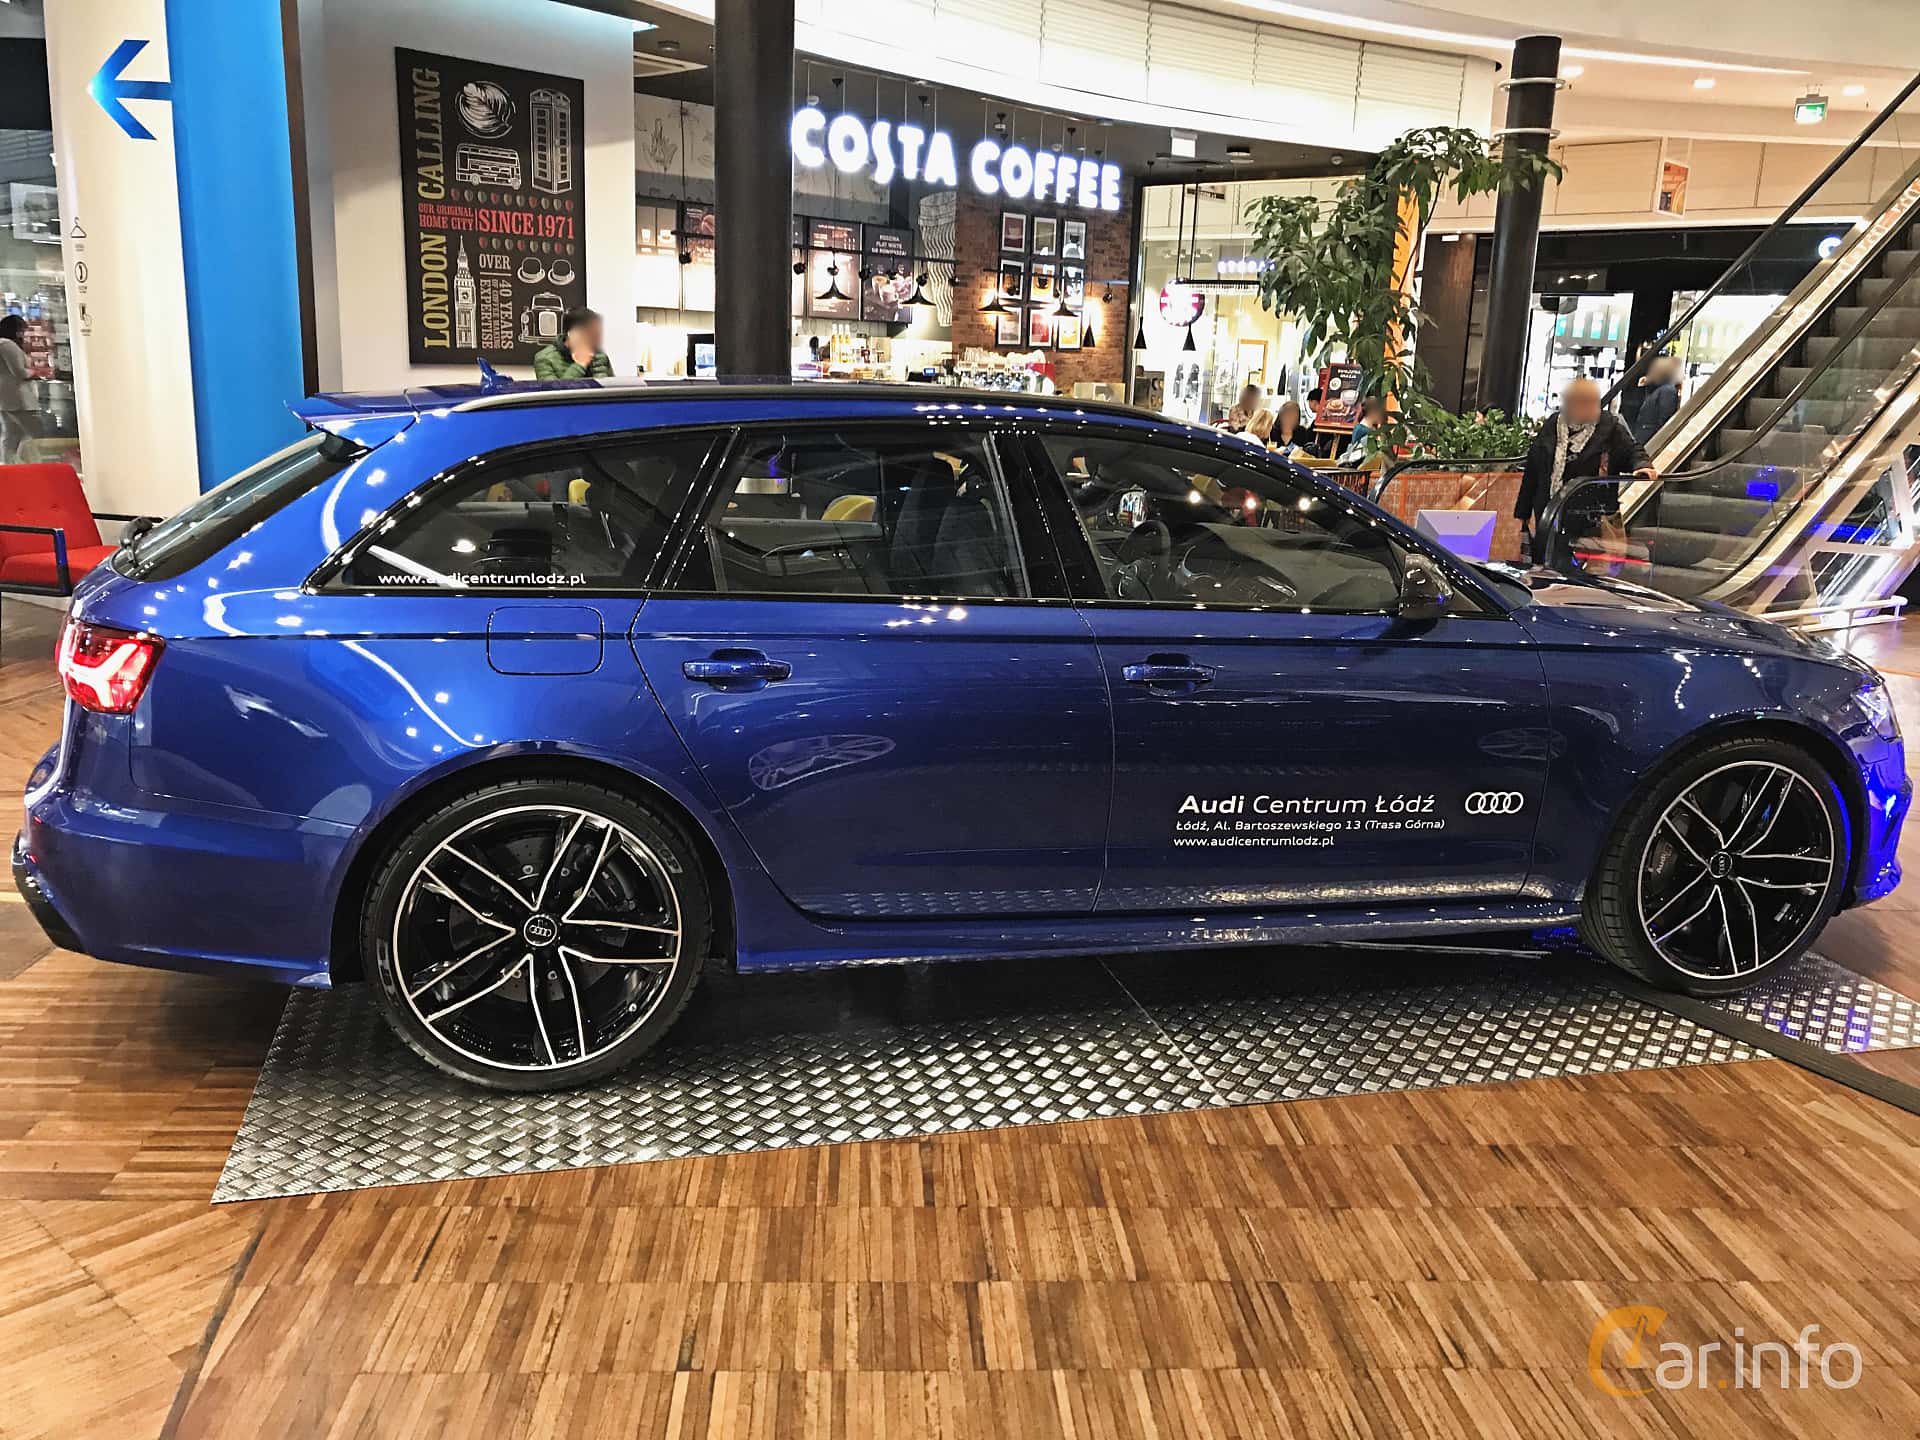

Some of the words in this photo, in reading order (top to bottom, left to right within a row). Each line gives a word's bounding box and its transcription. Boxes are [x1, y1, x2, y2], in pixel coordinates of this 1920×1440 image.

[412, 67, 446, 200] CALLING
[790, 108, 957, 186] COSTA
[972, 140, 1121, 211] COFFEE
[418, 203, 435, 214] OUR
[436, 205, 474, 218] ORIGINAL
[418, 214, 449, 229] HOME
[451, 217, 475, 231] CITY
[478, 208, 535, 236] SINCE
[537, 214, 574, 240] 1971
[479, 253, 512, 270] OVER
[420, 232, 450, 349] LONDON
[499, 279, 513, 297] 40
[480, 279, 493, 349] EXPERTISE
[500, 301, 514, 349] YEARS
[378, 572, 587, 586] www.adicentrumlodz.pl
[1178, 795, 1245, 814] Audi
[1253, 795, 1367, 814] Centrum
[1375, 794, 1436, 813] Łódź
[1176, 820, 1210, 832] Łódź,
[1213, 820, 1231, 831] Al.
[1235, 820, 1342, 832] Bartoszewskiego
[1345, 820, 1361, 830] 13
[1365, 819, 1402, 831] (Trasa
[1404, 819, 1445, 831] Górna)
[1173, 836, 1335, 848] www.audicentrumlodz.pl
